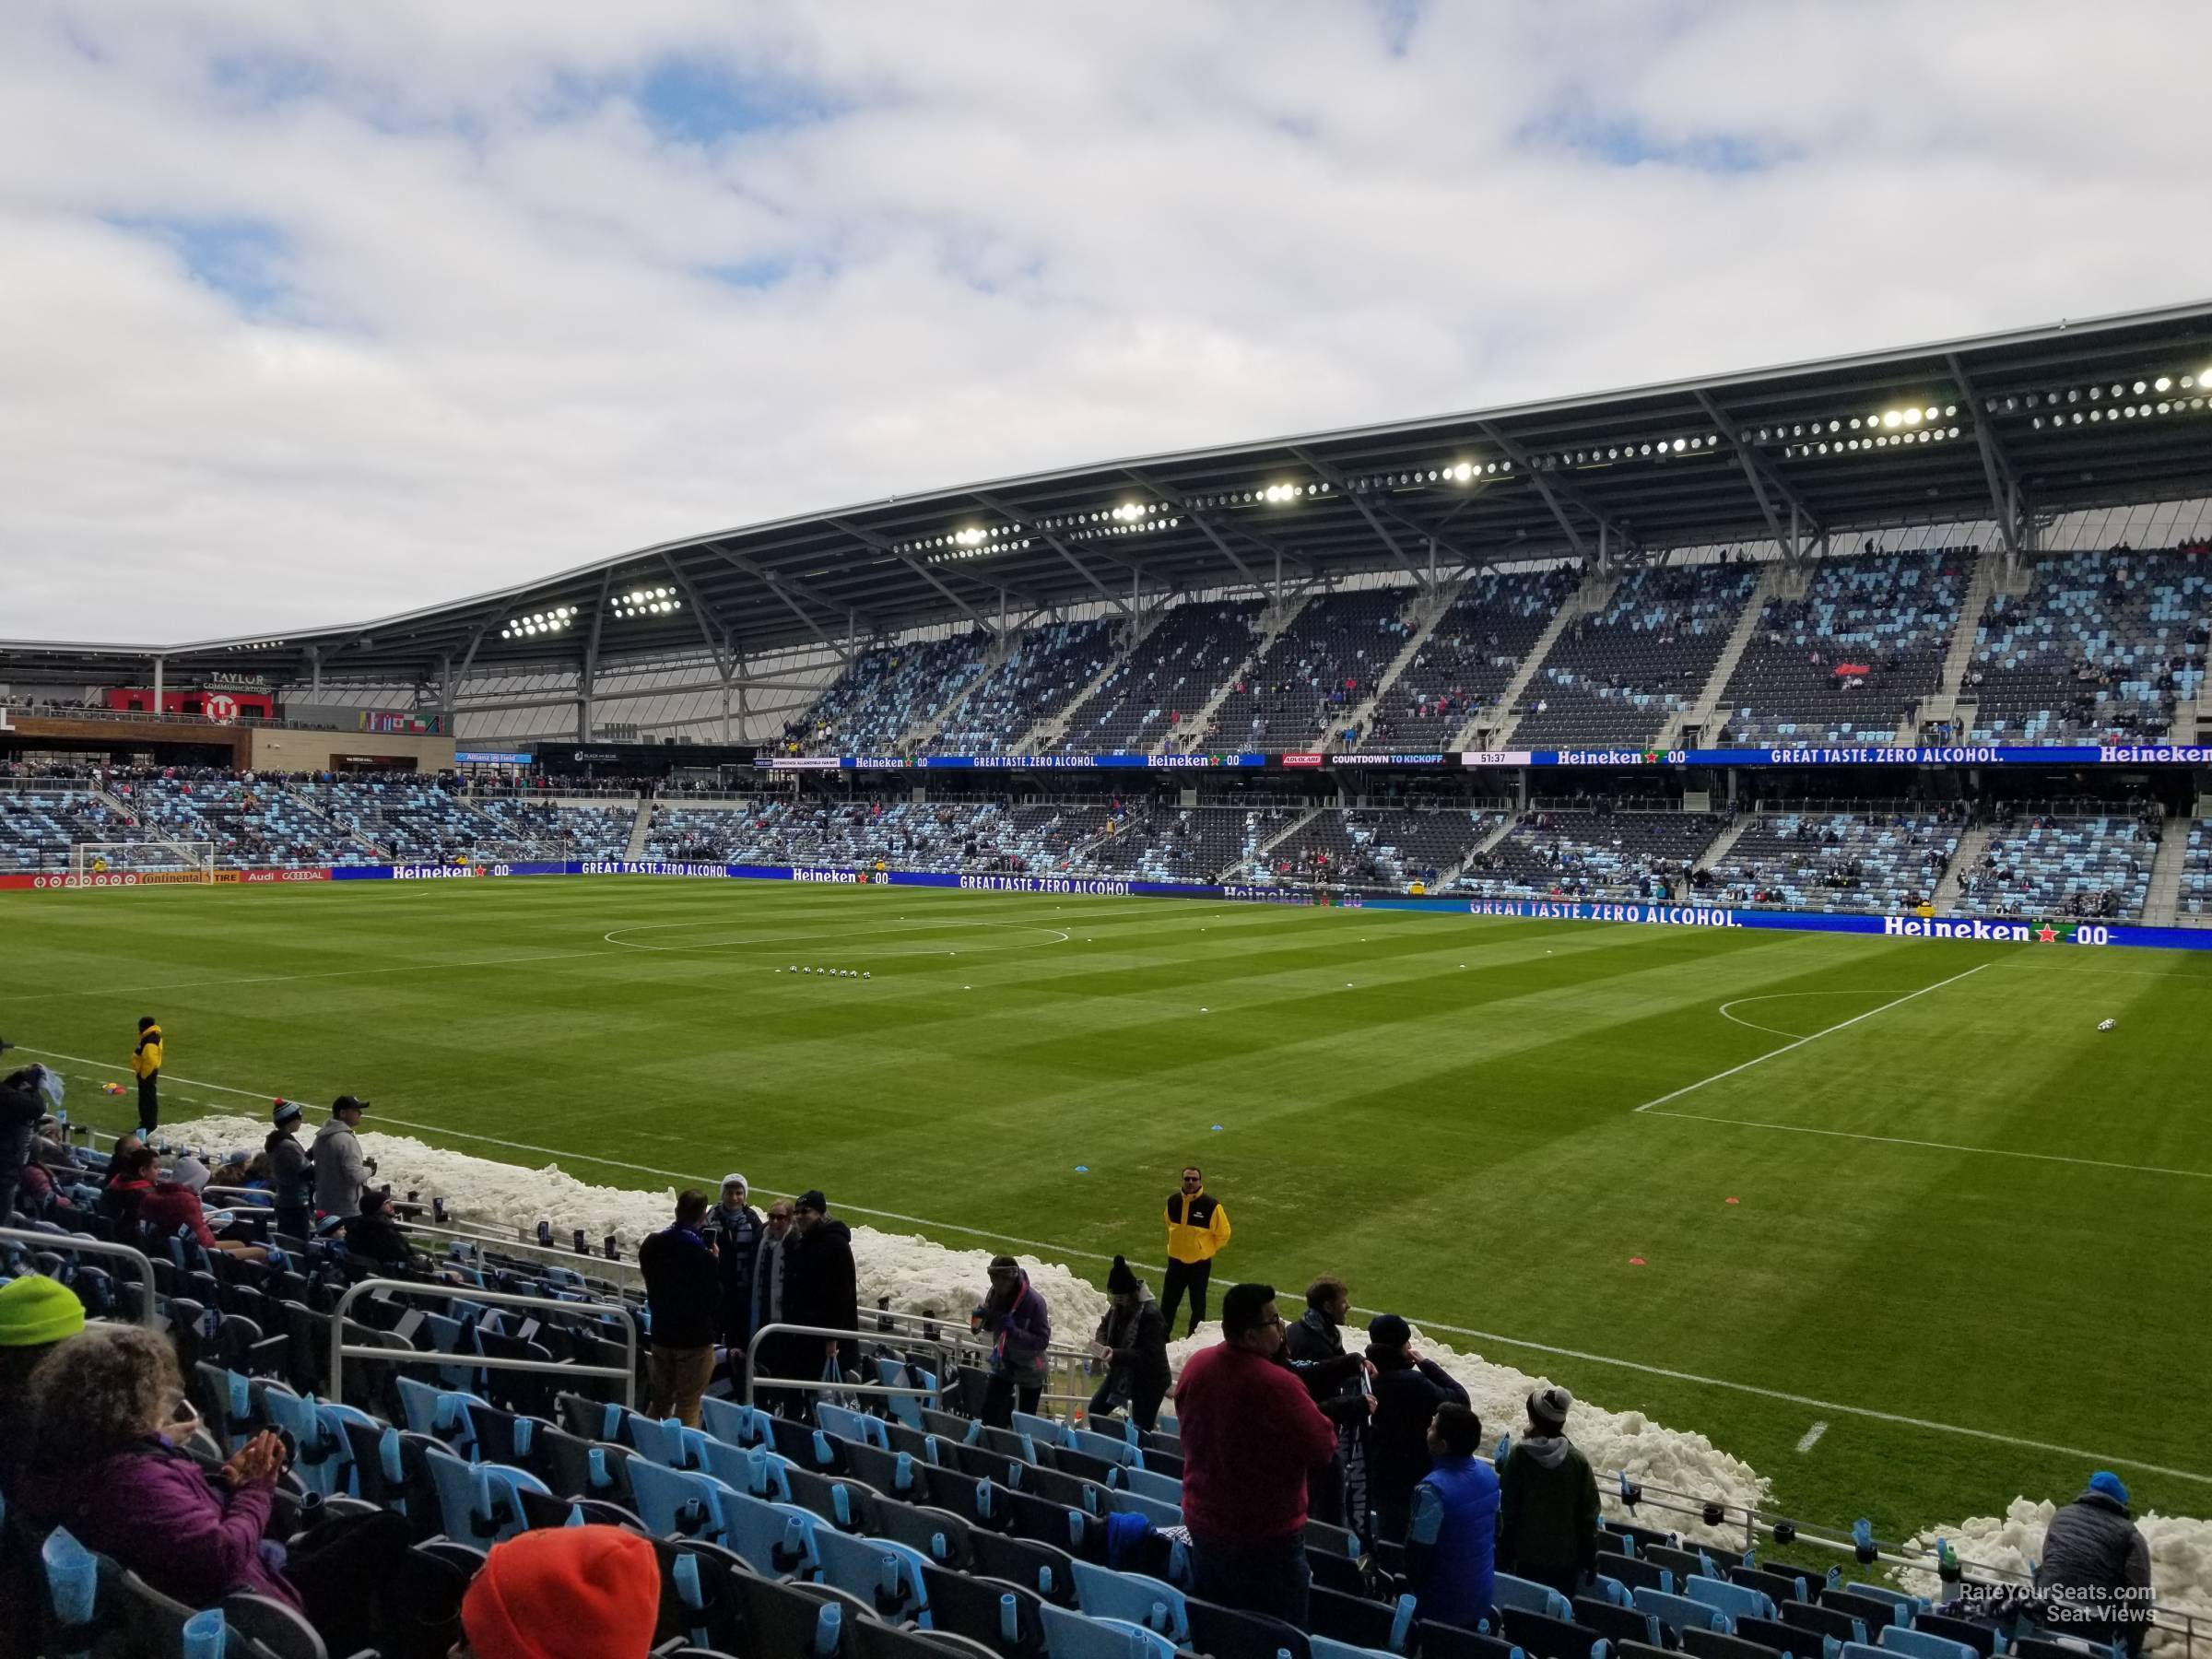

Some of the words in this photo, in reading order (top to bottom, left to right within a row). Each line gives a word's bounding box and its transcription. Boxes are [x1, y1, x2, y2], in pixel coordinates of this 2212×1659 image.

[211, 672, 264, 685] TAYLOR
[1147, 755, 1208, 766] Heineken
[1333, 755, 1388, 764] COUNTDOWN
[1390, 755, 1402, 763] TO
[1480, 754, 1505, 763] 51:37
[1558, 751, 1642, 764] Heineken
[1771, 749, 1818, 762] GREAT
[1824, 749, 1873, 762] TASTE.
[1877, 748, 1917, 761] ZERO
[1924, 747, 2004, 762] ALCOHOL.
[855, 758, 903, 768] Heineken
[974, 758, 999, 767] GREAT
[1030, 757, 1053, 767] ZERO
[1054, 756, 1098, 767] ALCOHOL.
[393, 865, 471, 878] Heineken
[582, 862, 618, 874] GREAT
[661, 864, 684, 875] ZERO
[688, 865, 730, 877] ALCOHOL.
[794, 868, 855, 883] Heineken
[143, 871, 202, 884] Continental
[215, 874, 236, 882] TIRE
[248, 873, 274, 881] Audi
[960, 876, 995, 889] GREAT
[1039, 878, 1070, 893] ZERO
[1075, 880, 1135, 897] ALCOHOL.
[1223, 886, 1314, 906] Heineken
[1470, 899, 1522, 915] GREAT
[1530, 902, 1587, 920] TASTE.
[1591, 904, 1639, 923] ZERO
[1646, 907, 1742, 928] ALCOHOL.
[1883, 916, 2031, 942] Heineken
